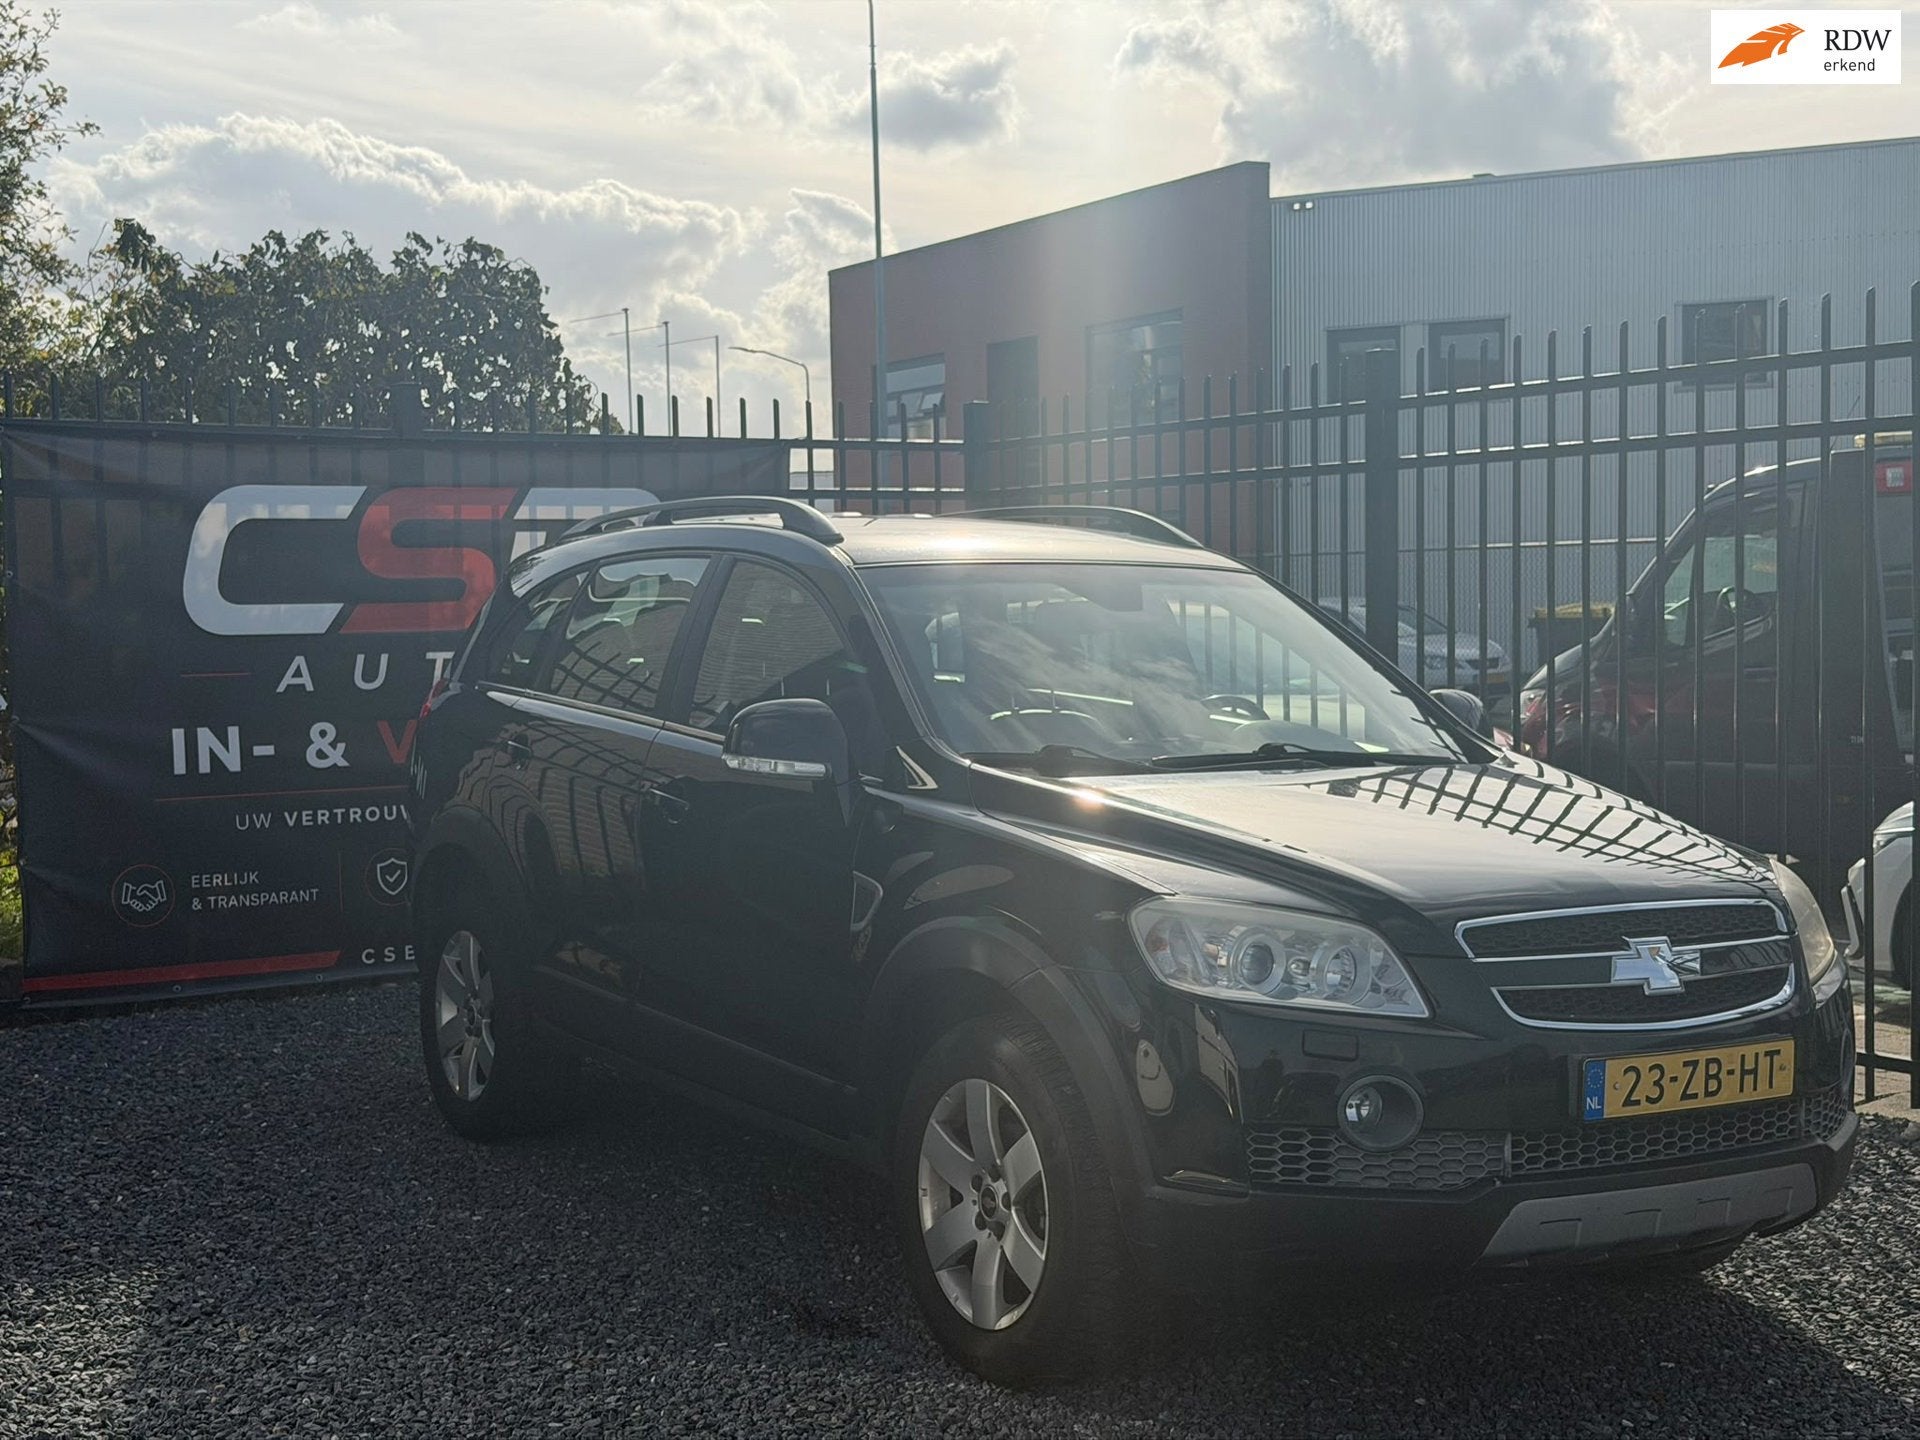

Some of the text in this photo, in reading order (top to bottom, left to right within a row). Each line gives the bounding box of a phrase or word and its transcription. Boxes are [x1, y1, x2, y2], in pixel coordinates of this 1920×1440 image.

[172, 725, 276, 775] IN-
[305, 721, 350, 769] &
[235, 812, 272, 831] UW
[191, 871, 260, 889] EERLIJK
[192, 888, 320, 911] & TRANSPARANT
[1621, 1048, 1782, 1108] 23-ZB-HT
[1586, 1095, 1602, 1111] NL
